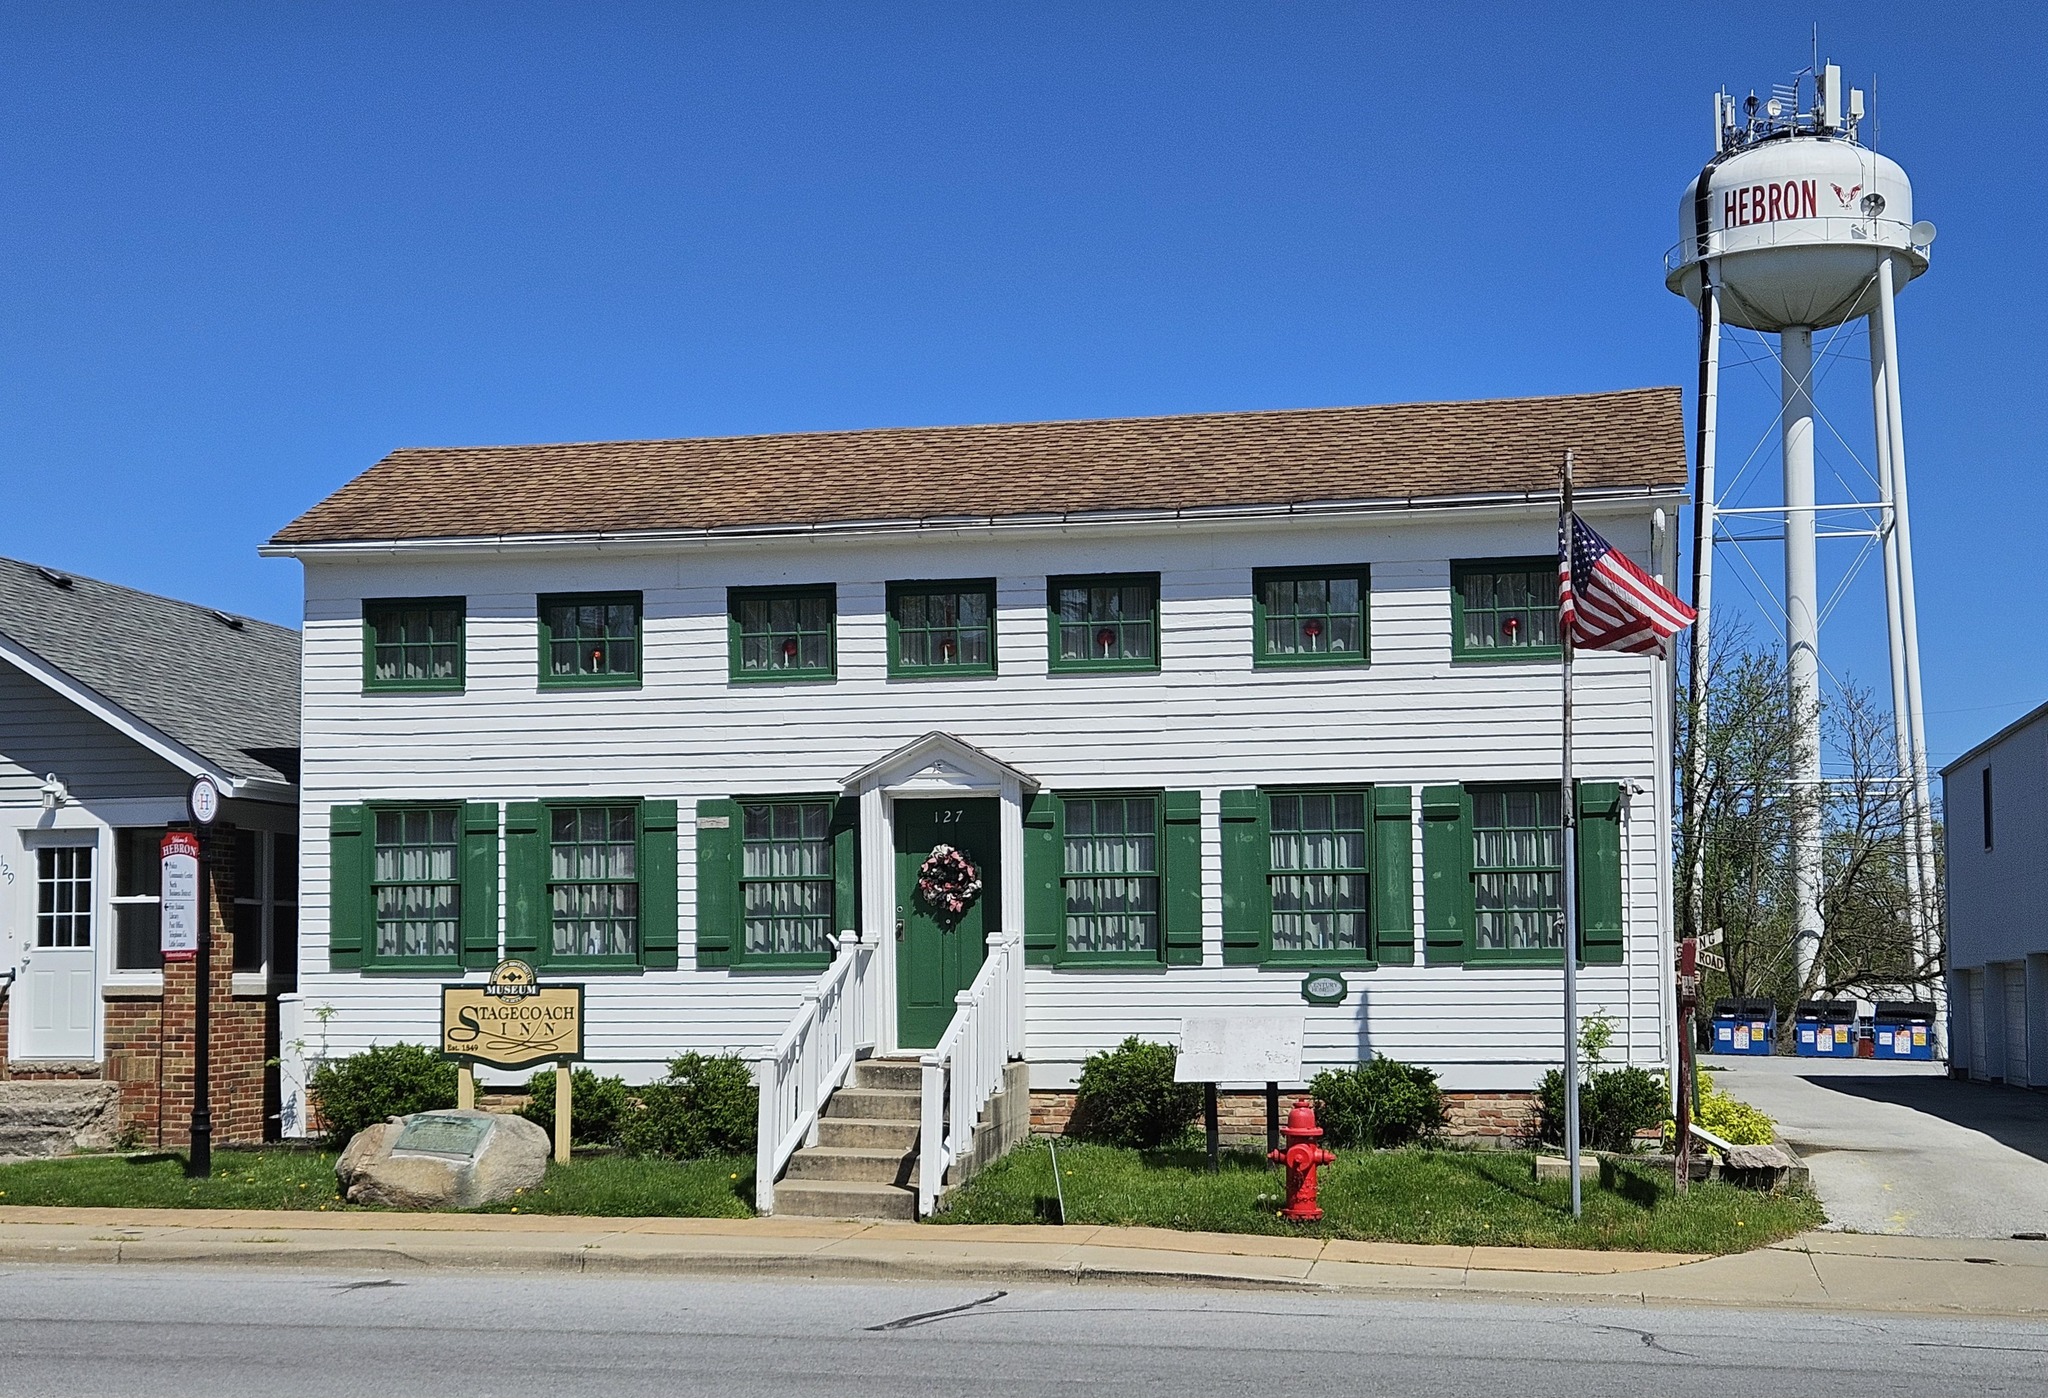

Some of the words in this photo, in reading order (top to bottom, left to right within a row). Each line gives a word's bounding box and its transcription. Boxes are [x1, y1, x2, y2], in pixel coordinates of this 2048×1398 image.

[1724, 179, 1817, 228] HEBRON
[934, 810, 963, 823] 127
[162, 843, 197, 857] HEBRON
[0, 854, 15, 885] 129
[1699, 951, 1724, 970] ROAD
[486, 985, 537, 995] MUSEUM
[448, 1005, 575, 1042] STAGECOACH
[501, 1022, 556, 1036] INN
